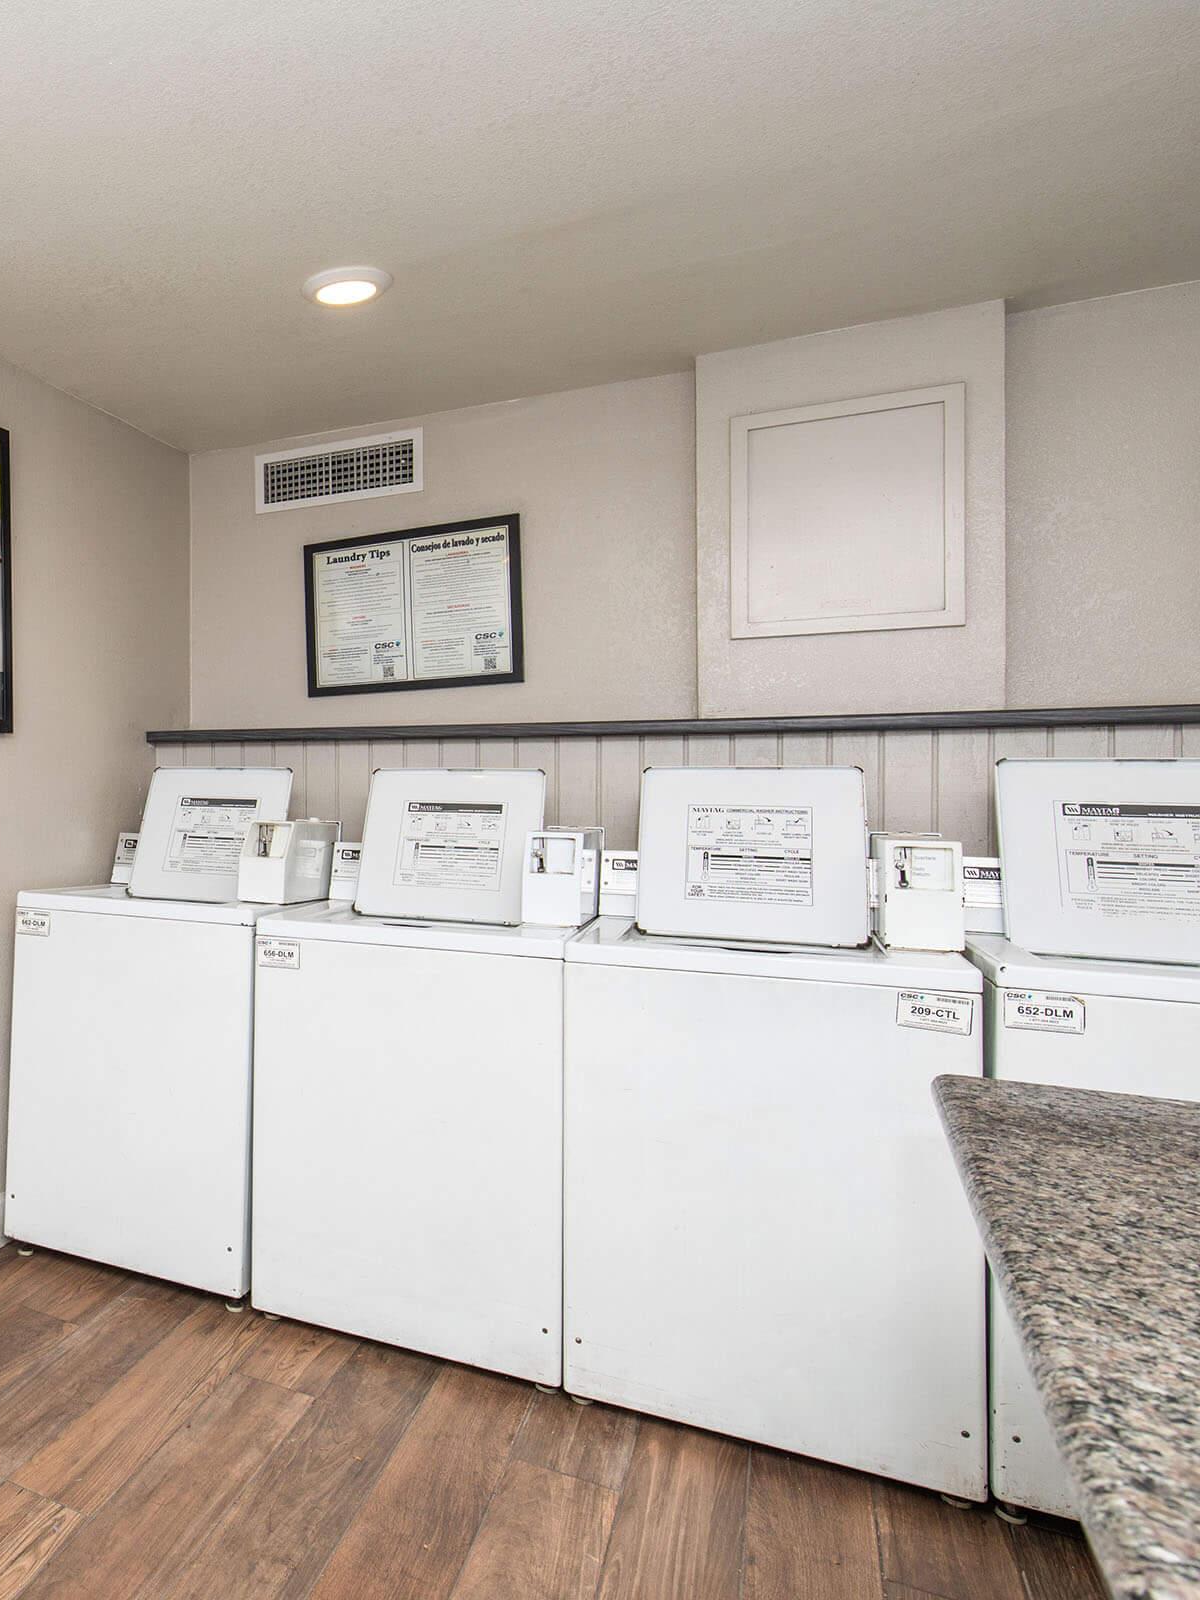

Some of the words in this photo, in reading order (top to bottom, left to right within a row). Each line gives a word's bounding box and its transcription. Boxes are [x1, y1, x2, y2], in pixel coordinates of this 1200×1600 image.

[411, 541, 441, 553] Consejos
[442, 539, 450, 549] de
[452, 536, 474, 547] lavado
[476, 537, 480, 546] y
[481, 532, 505, 543] secado
[326, 552, 367, 565] Laundry
[368, 549, 391, 560] Tips
[475, 632, 497, 640] CSC
[1081, 807, 1120, 816] MAYTAG
[981, 870, 1000, 878] MAY
[900, 992, 919, 1000] CSC
[910, 1005, 961, 1020] 209-CTL
[1017, 1005, 1074, 1019] 652-DLM
